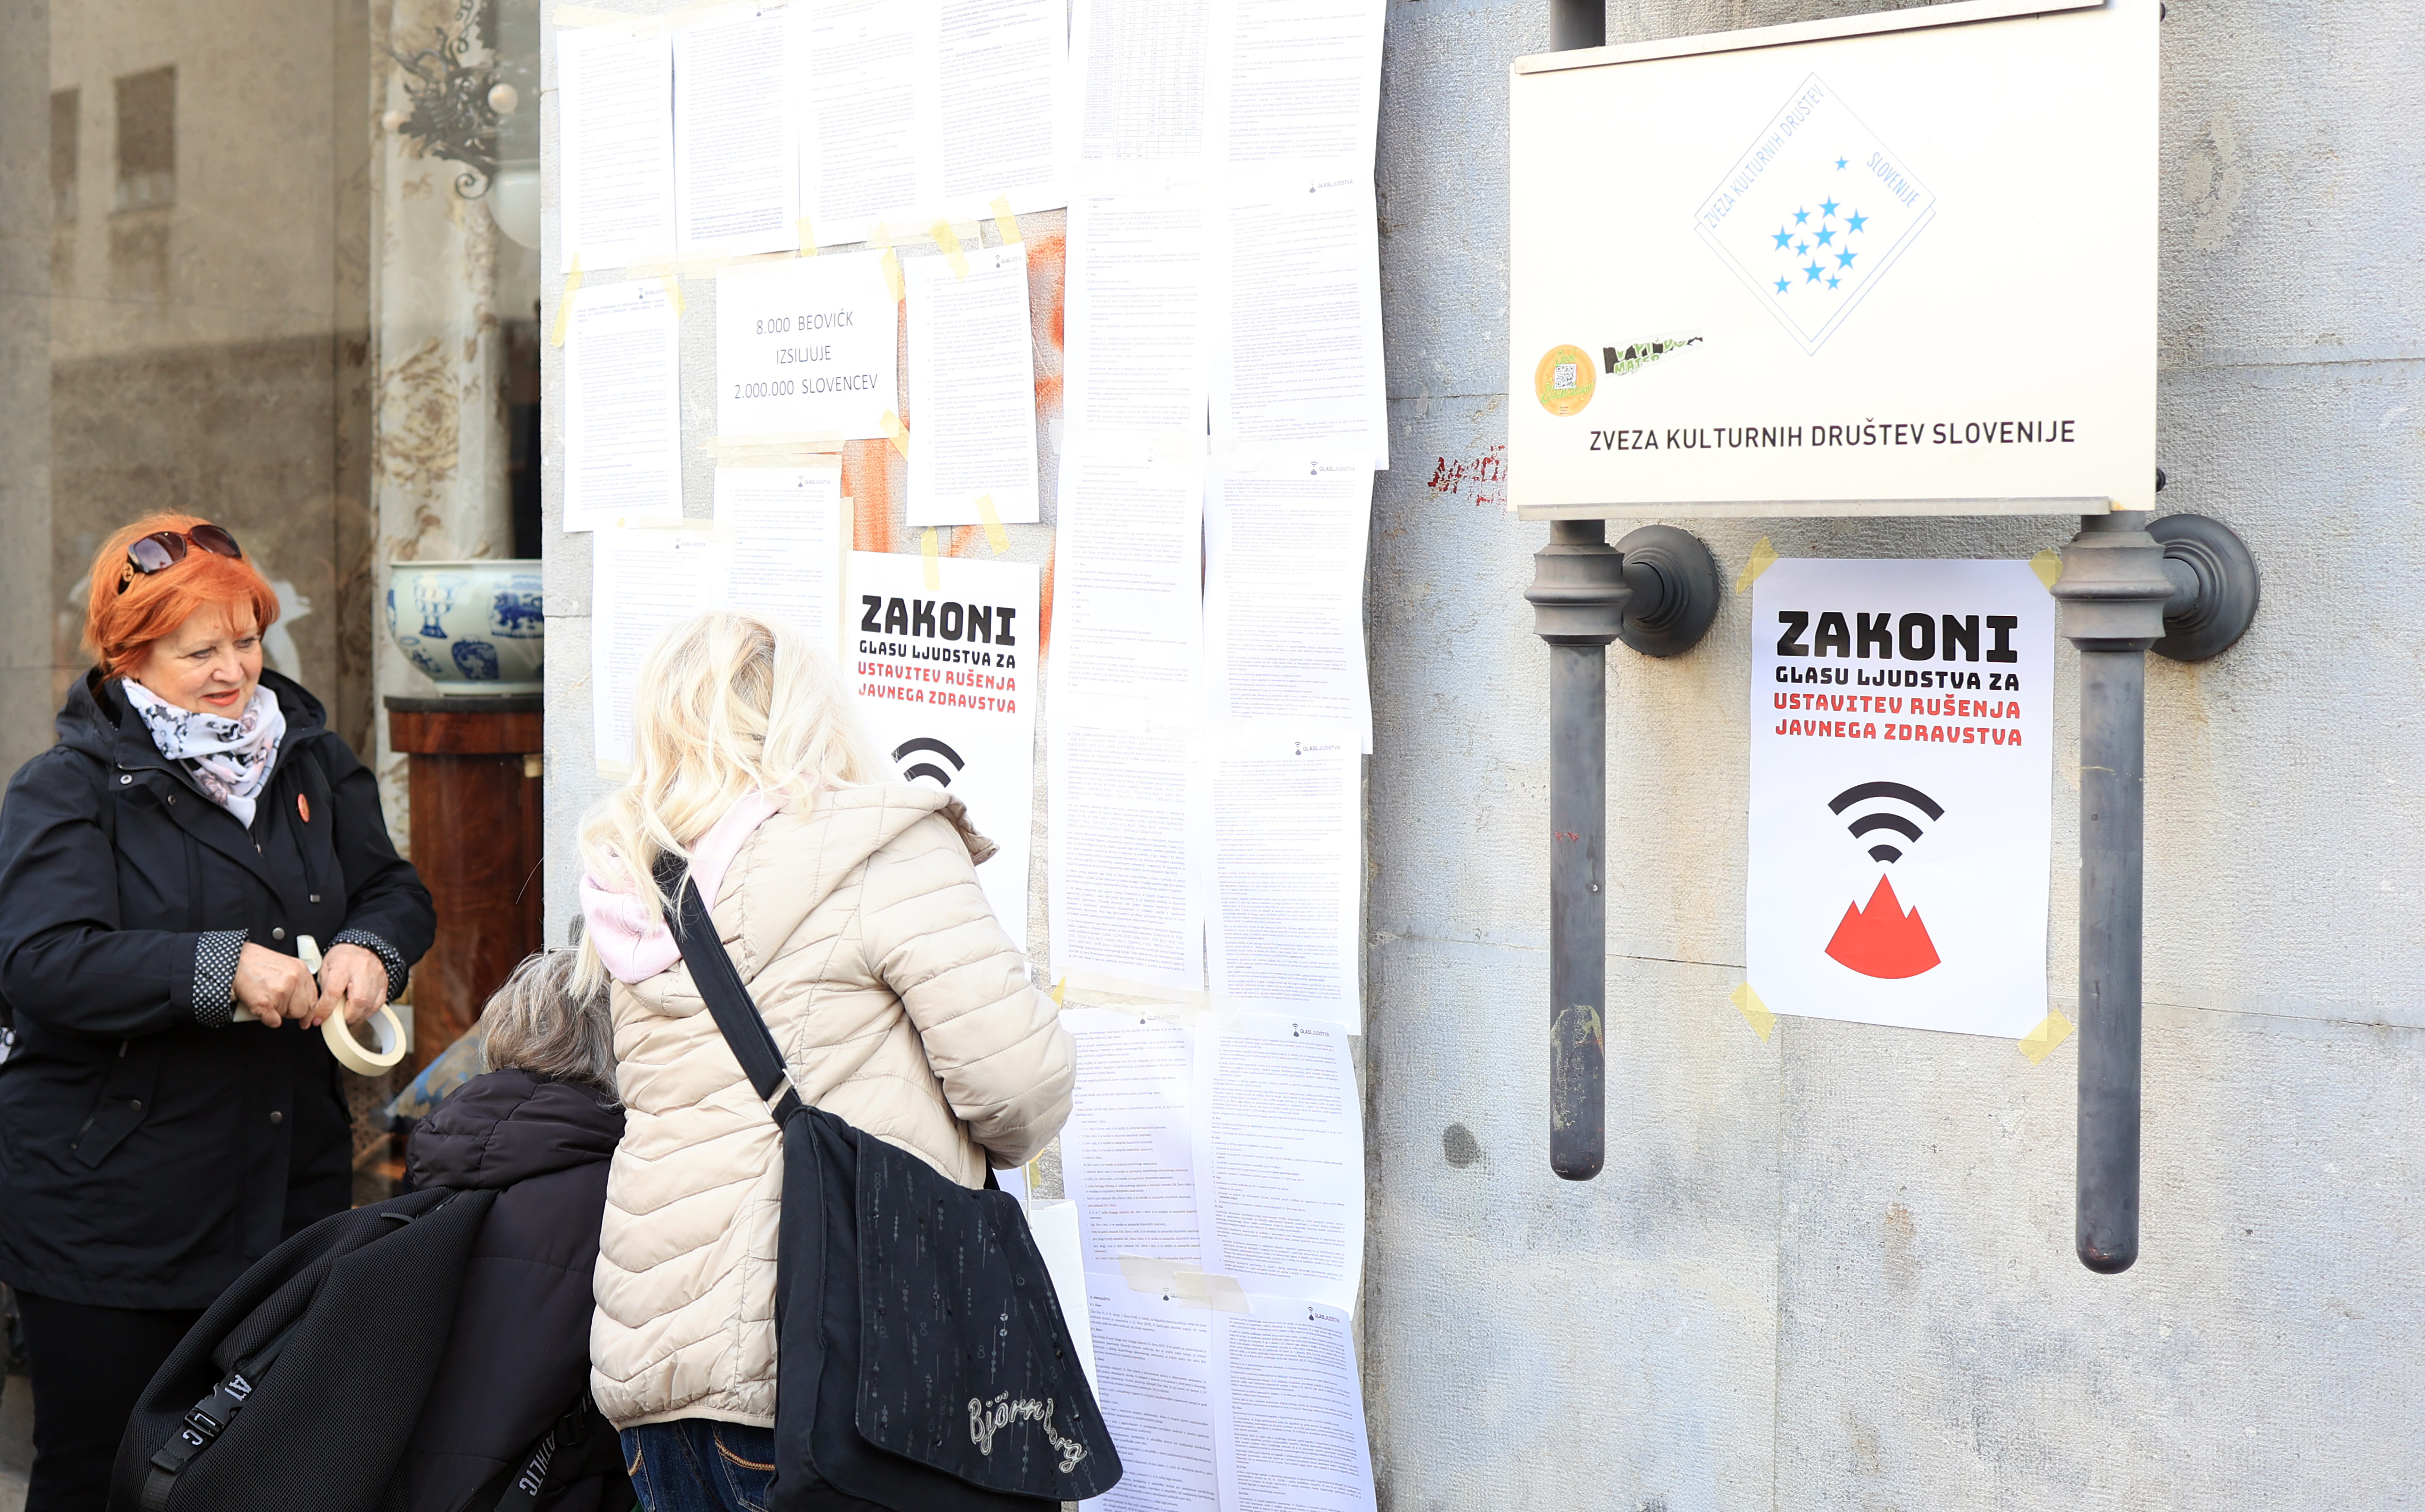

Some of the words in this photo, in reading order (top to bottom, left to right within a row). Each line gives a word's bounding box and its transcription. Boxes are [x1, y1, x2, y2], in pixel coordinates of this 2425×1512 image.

[1703, 192, 1737, 229] ZVEZA
[1730, 131, 1785, 196] KULTURNIH
[1779, 83, 1824, 137] DRUŠTEV
[1317, 179, 1353, 188] GLASLJUDSTVA
[1867, 152, 1920, 208] SLOVENIJE
[756, 317, 790, 335] 8.000
[798, 308, 853, 331] BEOVIĆK
[777, 345, 831, 364] IZSILJUJE
[735, 380, 794, 399] 2.000.000
[802, 374, 878, 394] SLOVENCEV
[1590, 430, 1658, 451] ZVEZA
[1667, 426, 1802, 449] KULTURNIH
[1812, 418, 1924, 446] DRUŠTEV
[1933, 420, 2075, 444] SLOVENIJE
[861, 594, 1016, 647] ZAKONI
[1777, 610, 2018, 663] ZAKONI
[859, 639, 907, 657] GLASU
[912, 645, 991, 667] LJUDSTVA
[996, 654, 1015, 669] ZA
[858, 661, 941, 683] USTAVITEV
[946, 668, 1015, 691] RUŠENJA
[1776, 666, 1849, 685] GLASU
[1858, 669, 1981, 690] LJUDSTVA
[1989, 673, 2019, 691] ZA
[859, 683, 924, 702] JAVNEGA
[929, 690, 1016, 713] ZDRAVSTVA
[1774, 692, 1902, 714] USTAVITEV
[1911, 693, 2020, 719] RUŠENJA
[1776, 719, 1876, 739] JAVNEGA
[1884, 723, 2022, 746] ZDRAVSTVA
[1300, 1029, 1330, 1037] GLASLJUDSTVA
[968, 1390, 1045, 1456] Björn
